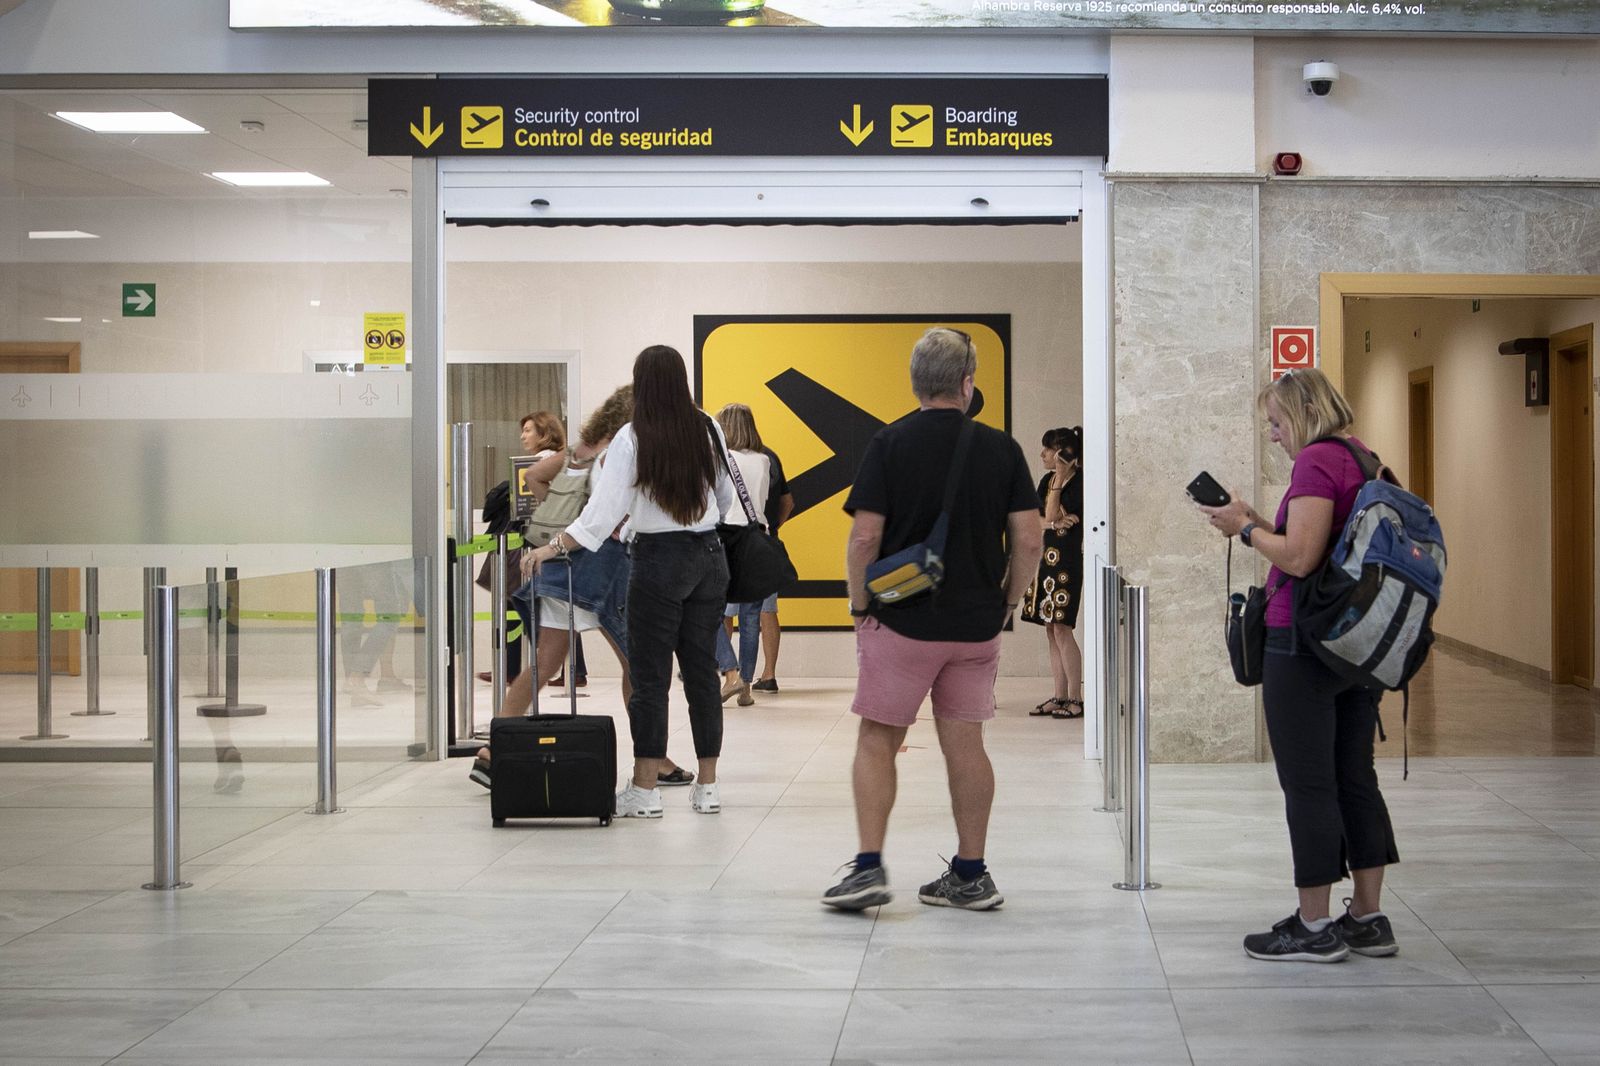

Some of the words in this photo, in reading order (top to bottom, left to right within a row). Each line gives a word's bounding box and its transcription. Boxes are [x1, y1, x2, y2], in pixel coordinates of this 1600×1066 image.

[972, 0, 1030, 11] Alhambra
[1034, 1, 1082, 11] Reserva
[1085, 1, 1112, 12] 1925
[1116, 2, 1187, 13] recomienda
[1190, 4, 1206, 13] un
[1208, 3, 1264, 13] consumo
[1267, 3, 1343, 15] responsable.
[1346, 4, 1369, 14] Alc.
[1372, 3, 1401, 15] 6,4%
[1404, 3, 1426, 14] vol.
[514, 108, 579, 127] Security
[585, 108, 639, 124] control
[946, 107, 1018, 126] Boarding
[514, 128, 583, 147] Control
[590, 128, 613, 147] de
[620, 128, 712, 149] seguridad
[946, 128, 1052, 150] Embarques
